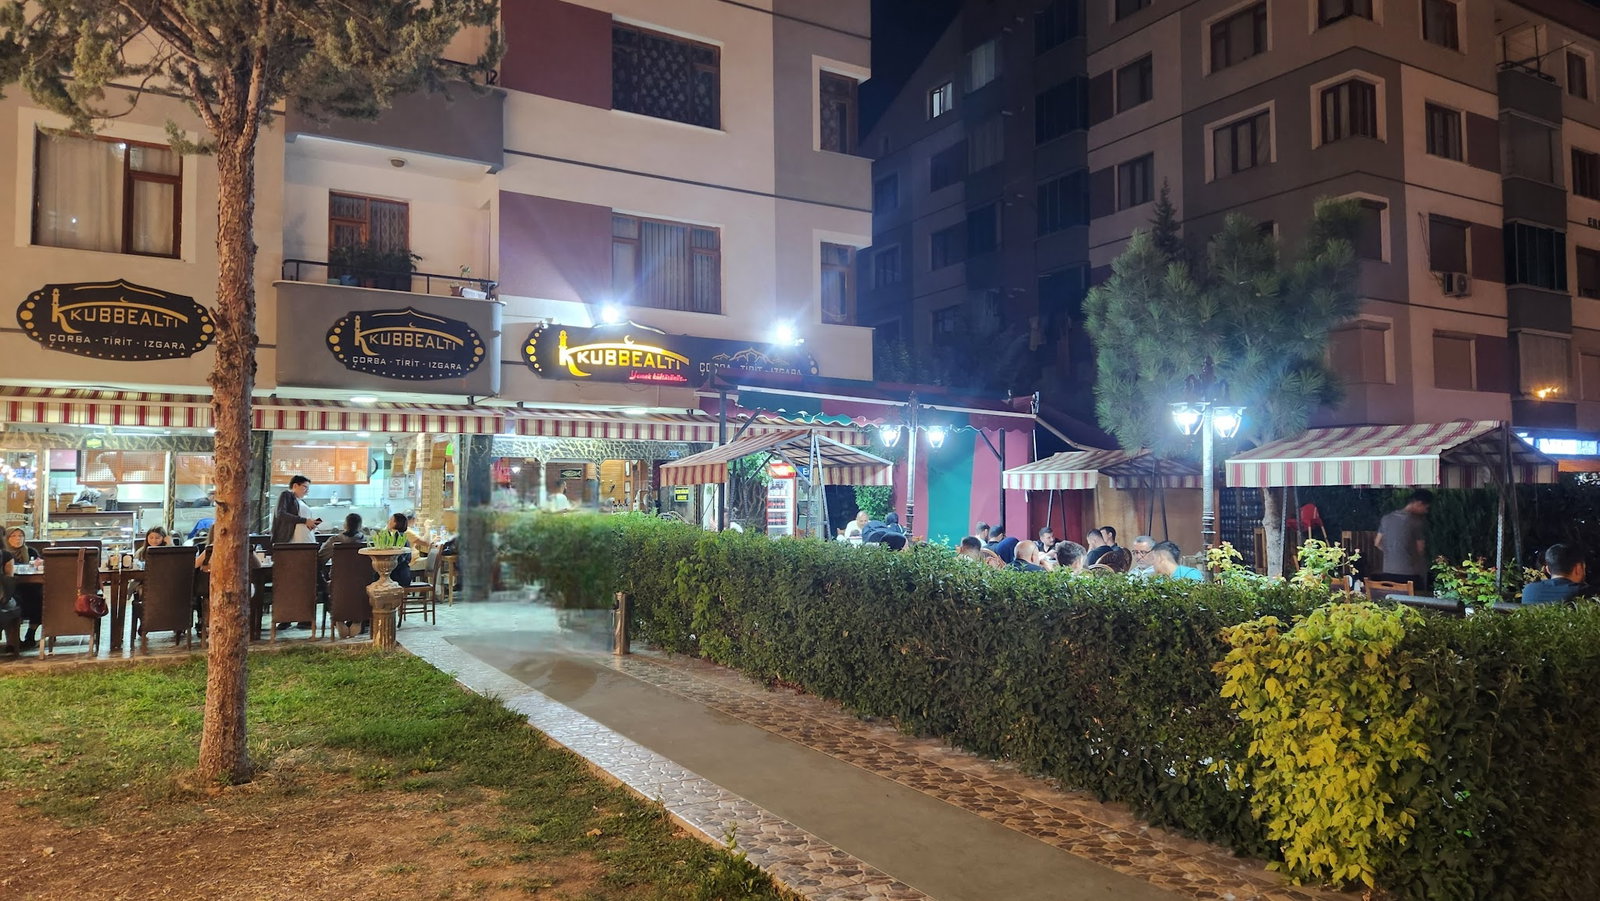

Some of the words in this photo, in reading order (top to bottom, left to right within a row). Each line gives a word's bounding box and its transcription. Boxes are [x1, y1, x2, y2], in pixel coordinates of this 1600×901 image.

[70, 308, 178, 328] KUBBEALTI
[50, 333, 91, 344] ÇORBA
[103, 336, 132, 346] TİRİT
[144, 340, 186, 350] IZGARA
[369, 333, 456, 350] KUBBEALTI
[352, 356, 386, 365] ÇORBA
[395, 358, 420, 367] TİRİT
[428, 361, 462, 370] IZGARA
[577, 349, 680, 370] KUBBEALTI
